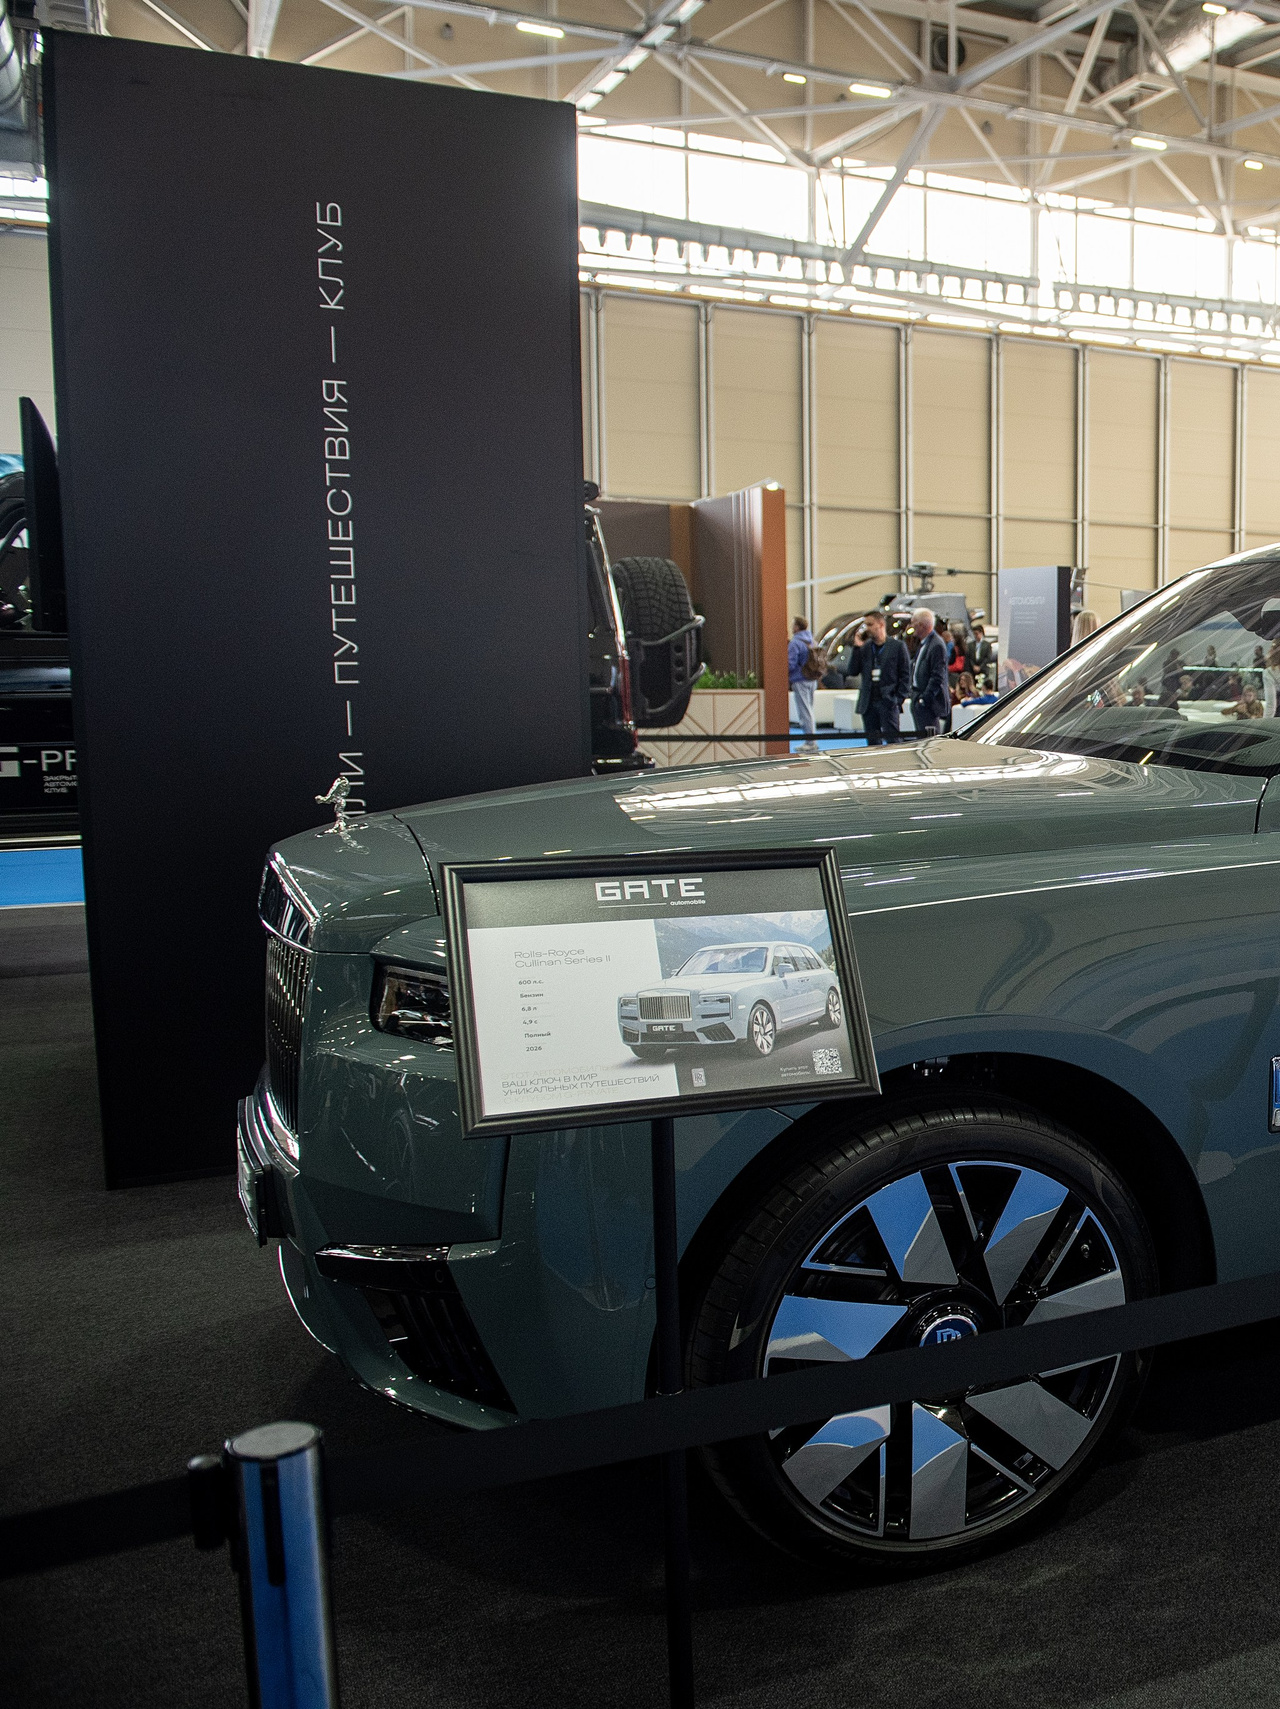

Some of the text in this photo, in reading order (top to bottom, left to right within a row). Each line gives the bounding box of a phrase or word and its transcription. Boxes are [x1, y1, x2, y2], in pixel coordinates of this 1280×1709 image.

[315, 201, 345, 310] КЛУБ
[322, 379, 361, 684] ПУТЕШЕСТВИЯ
[595, 878, 705, 901] GATE
[514, 949, 585, 959] Rolls-Royce
[515, 959, 561, 968] Cullinan
[564, 955, 603, 965] Series
[502, 1080, 527, 1089] ВАШ
[529, 1077, 561, 1086] КЛЮЧ
[573, 1073, 598, 1081] МИР
[503, 1074, 660, 1096] УНИКАЛЬНЫХ ПУТЕШЕСТВИЙ
